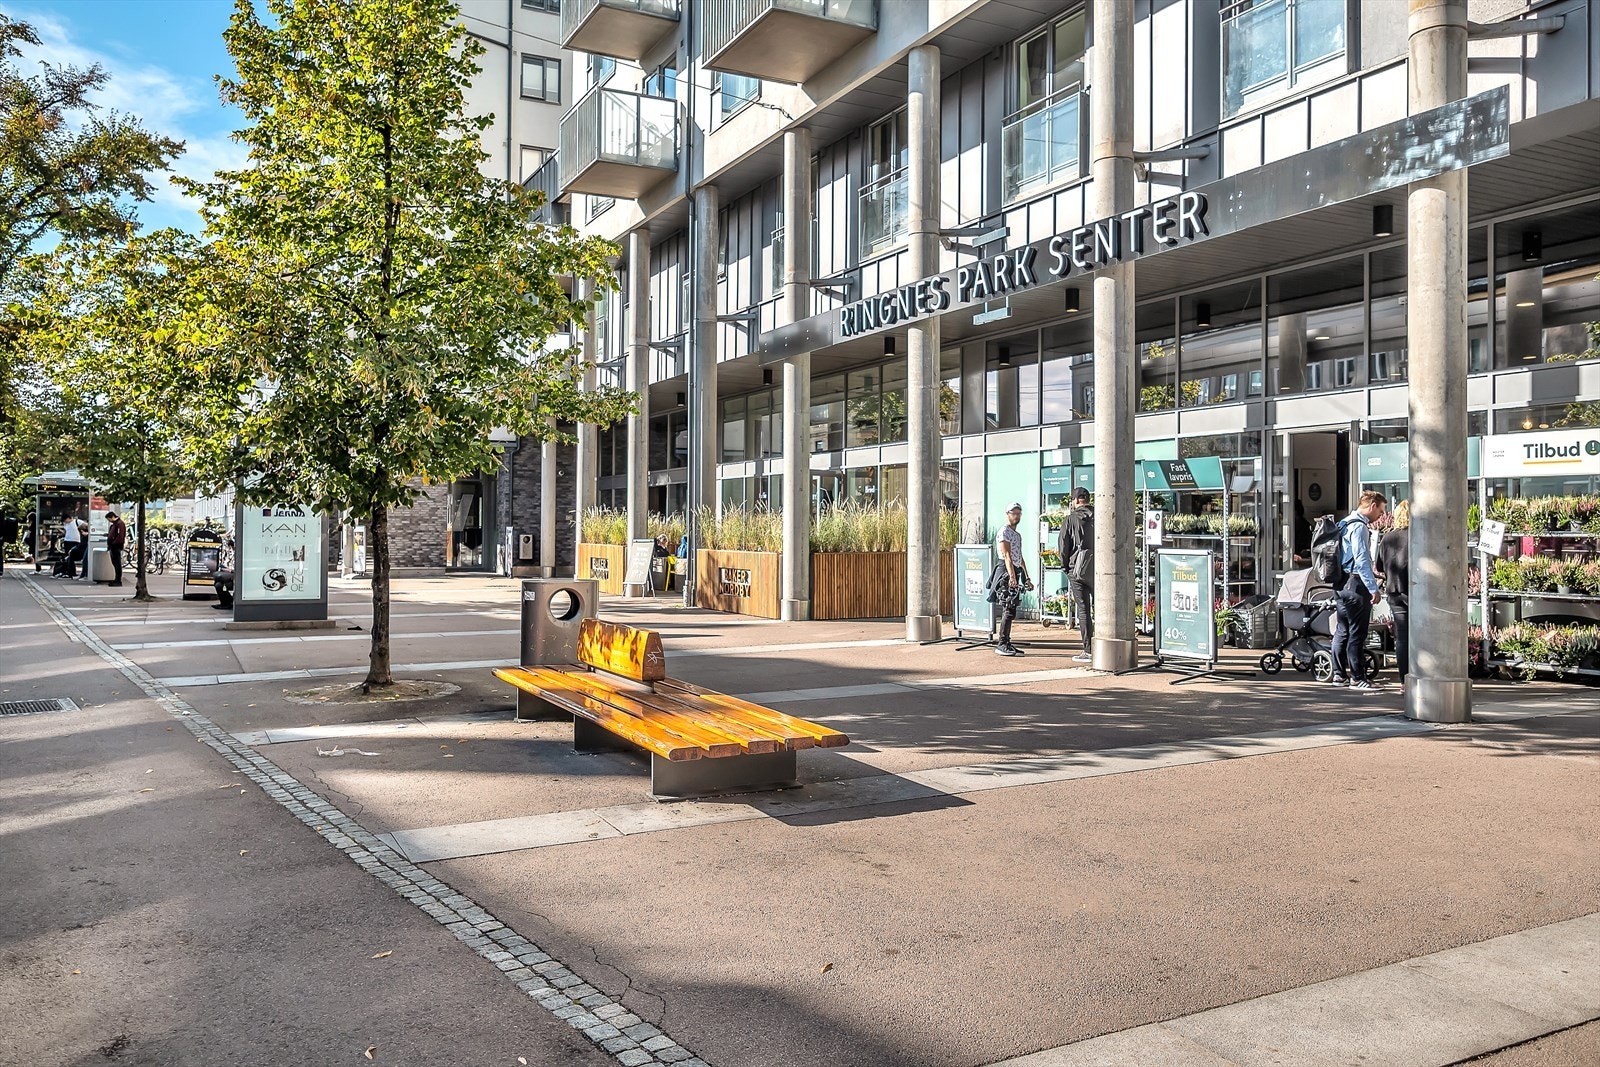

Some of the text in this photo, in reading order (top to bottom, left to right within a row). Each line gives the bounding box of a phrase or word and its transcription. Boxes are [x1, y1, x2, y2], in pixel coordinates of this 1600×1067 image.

[840, 191, 1208, 337] RINGNES PARK SENTER
[1523, 441, 1581, 459] Tilbud
[1170, 463, 1187, 472] Fast
[1169, 472, 1193, 483] lavpris
[262, 523, 306, 534] KAN
[1172, 571, 1198, 581] Tilbud
[1164, 626, 1187, 641] 40%
